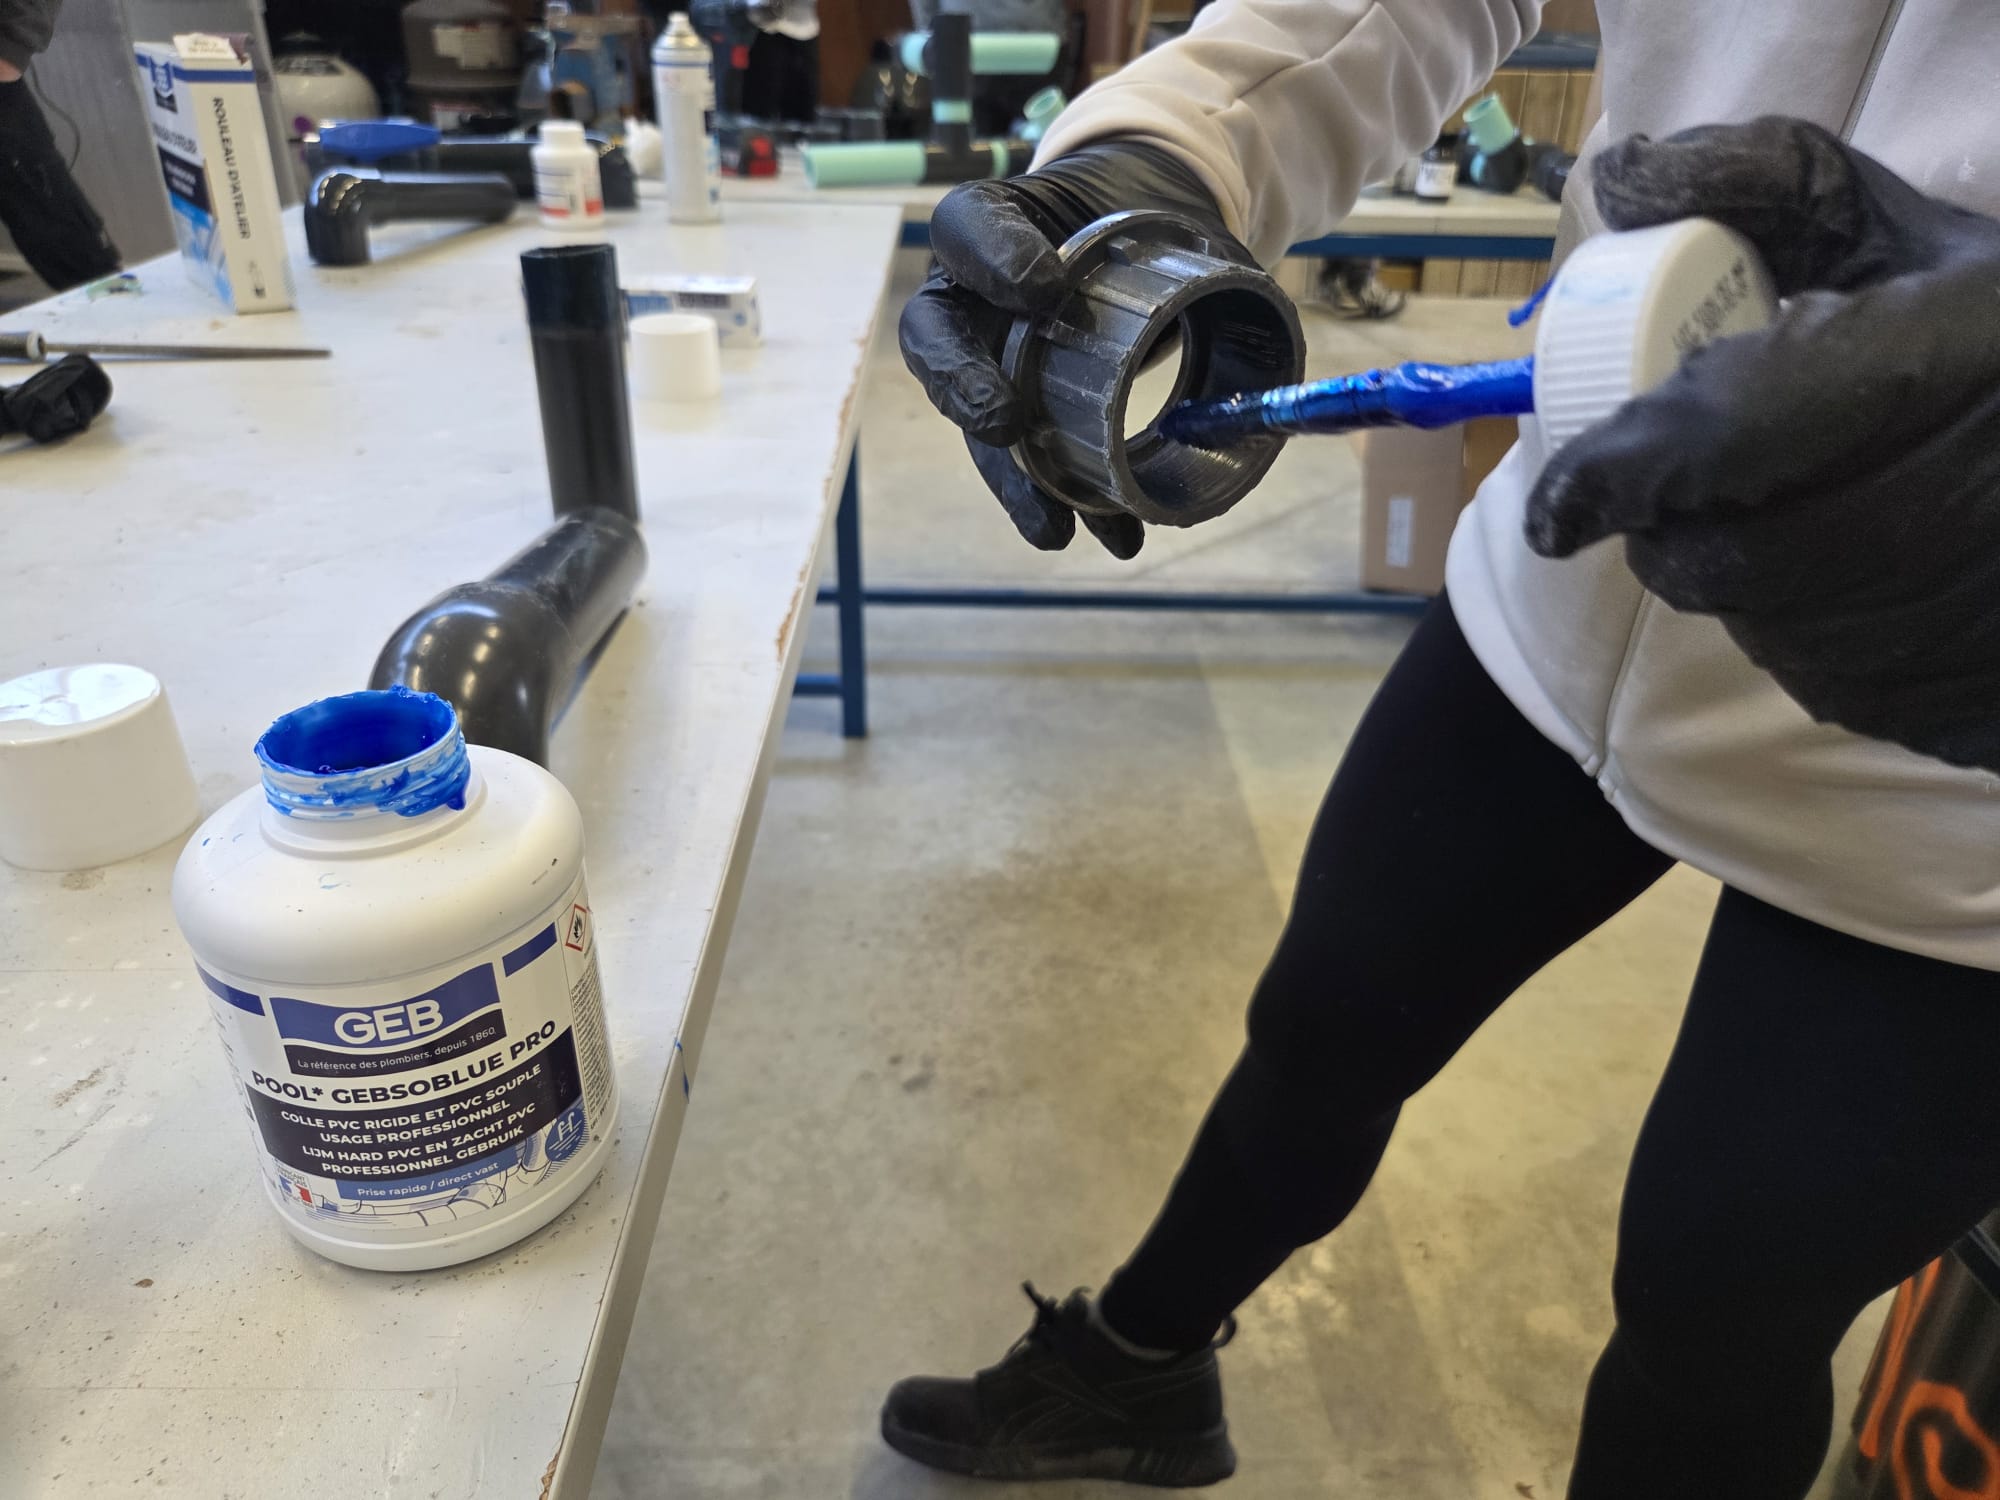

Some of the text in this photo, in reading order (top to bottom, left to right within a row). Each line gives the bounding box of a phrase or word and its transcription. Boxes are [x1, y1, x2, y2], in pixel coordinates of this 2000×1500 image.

[213, 96, 251, 240] ROULEAU D'ATELIER
[334, 999, 444, 1045] GEB
[297, 1059, 309, 1069] La
[310, 1058, 357, 1071] référence
[359, 1058, 378, 1069] des
[434, 1038, 468, 1057] depuis
[469, 1026, 495, 1043] 1860
[331, 1052, 505, 1104] GEBSOBLUE
[510, 1020, 555, 1060] PRO
[281, 1063, 542, 1130] COLLE PVC RIGIDE ET PVC SOUPLE
[319, 1100, 511, 1145] USAGE PROFESSIONNEL
[302, 1102, 536, 1161] LIJM HARD PVC EN ZACHT PVC
[322, 1124, 525, 1176] PROFESSIONNEL GEBRUIK
[357, 1186, 387, 1197] Prise
[388, 1181, 429, 1198] rapide
[437, 1170, 474, 1188] direct
[473, 1162, 500, 1177] vast
